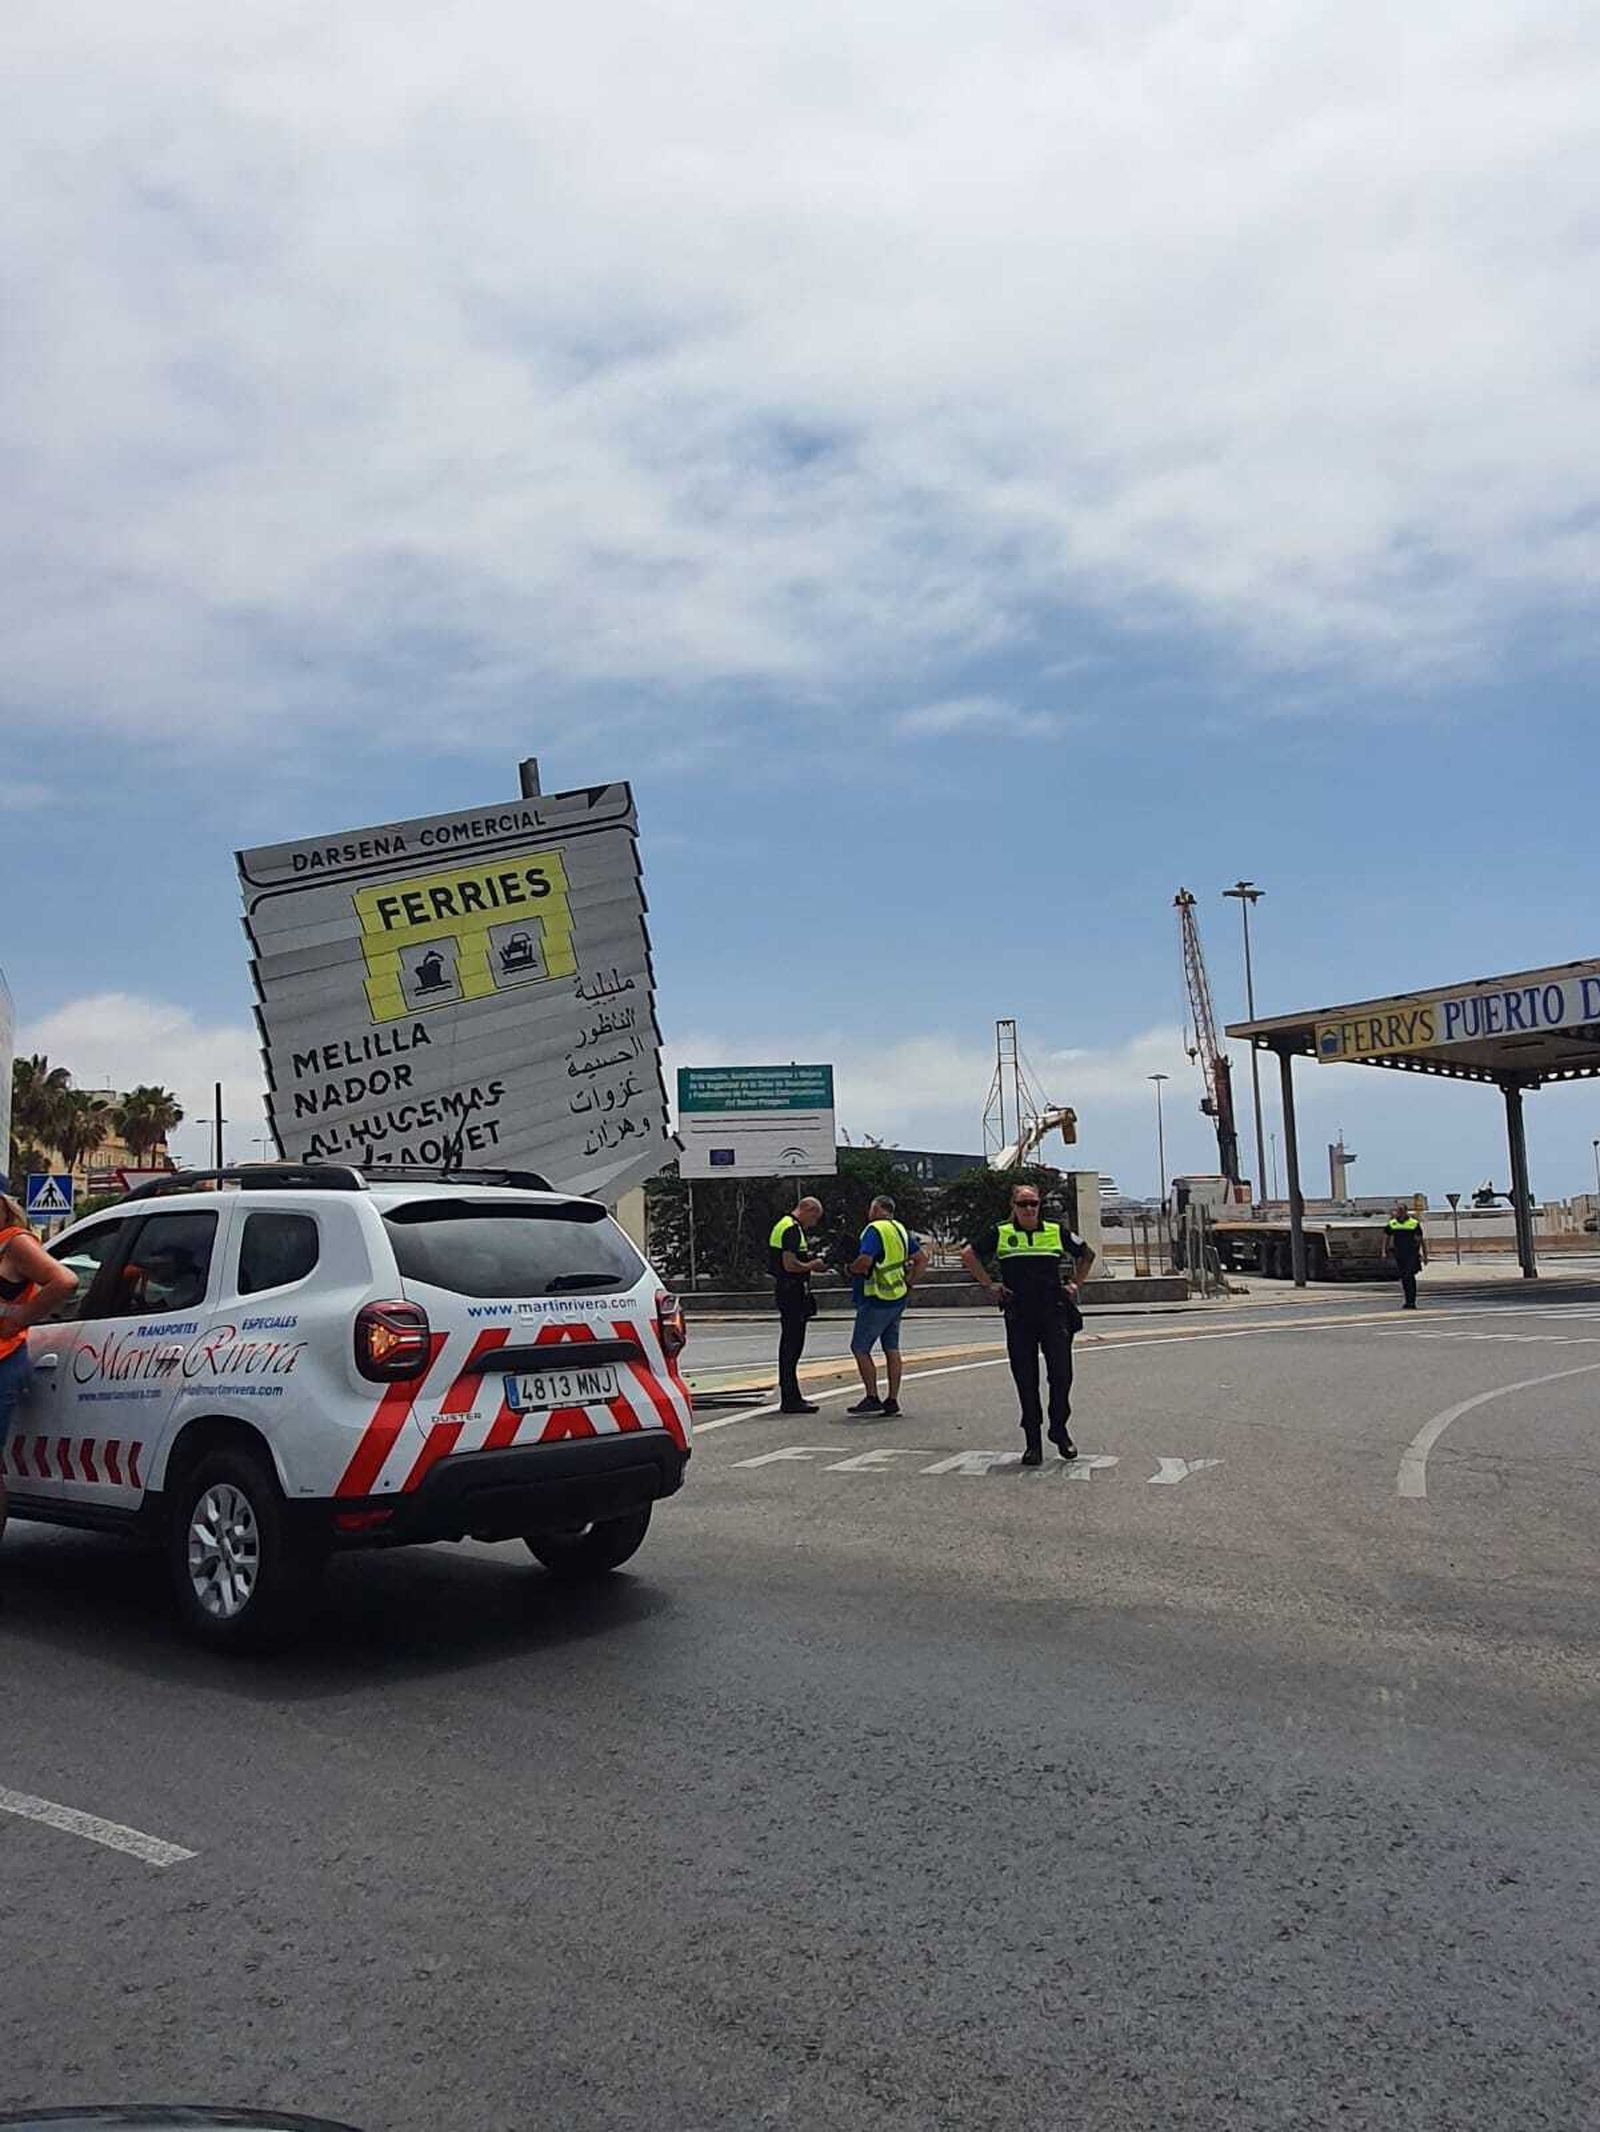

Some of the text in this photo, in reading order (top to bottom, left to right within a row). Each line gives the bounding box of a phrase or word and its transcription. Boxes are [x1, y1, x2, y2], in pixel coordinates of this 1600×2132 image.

[292, 810, 546, 873] DARSENA COMERCIAL
[375, 867, 552, 931] FERRIES
[1340, 1009, 1435, 1054] FERRYS
[1443, 985, 1565, 1040] PUERTO
[292, 1022, 432, 1079] MELILLA
[293, 1063, 414, 1119] NADOR
[302, 1081, 506, 1164] ALHUCEMAS
[241, 1315, 298, 1331] ESPECIALES
[467, 1298, 638, 1318] www.martinrivera.com
[521, 1373, 613, 1401] 4813 MNJ
[431, 1412, 482, 1424] DUSTER
